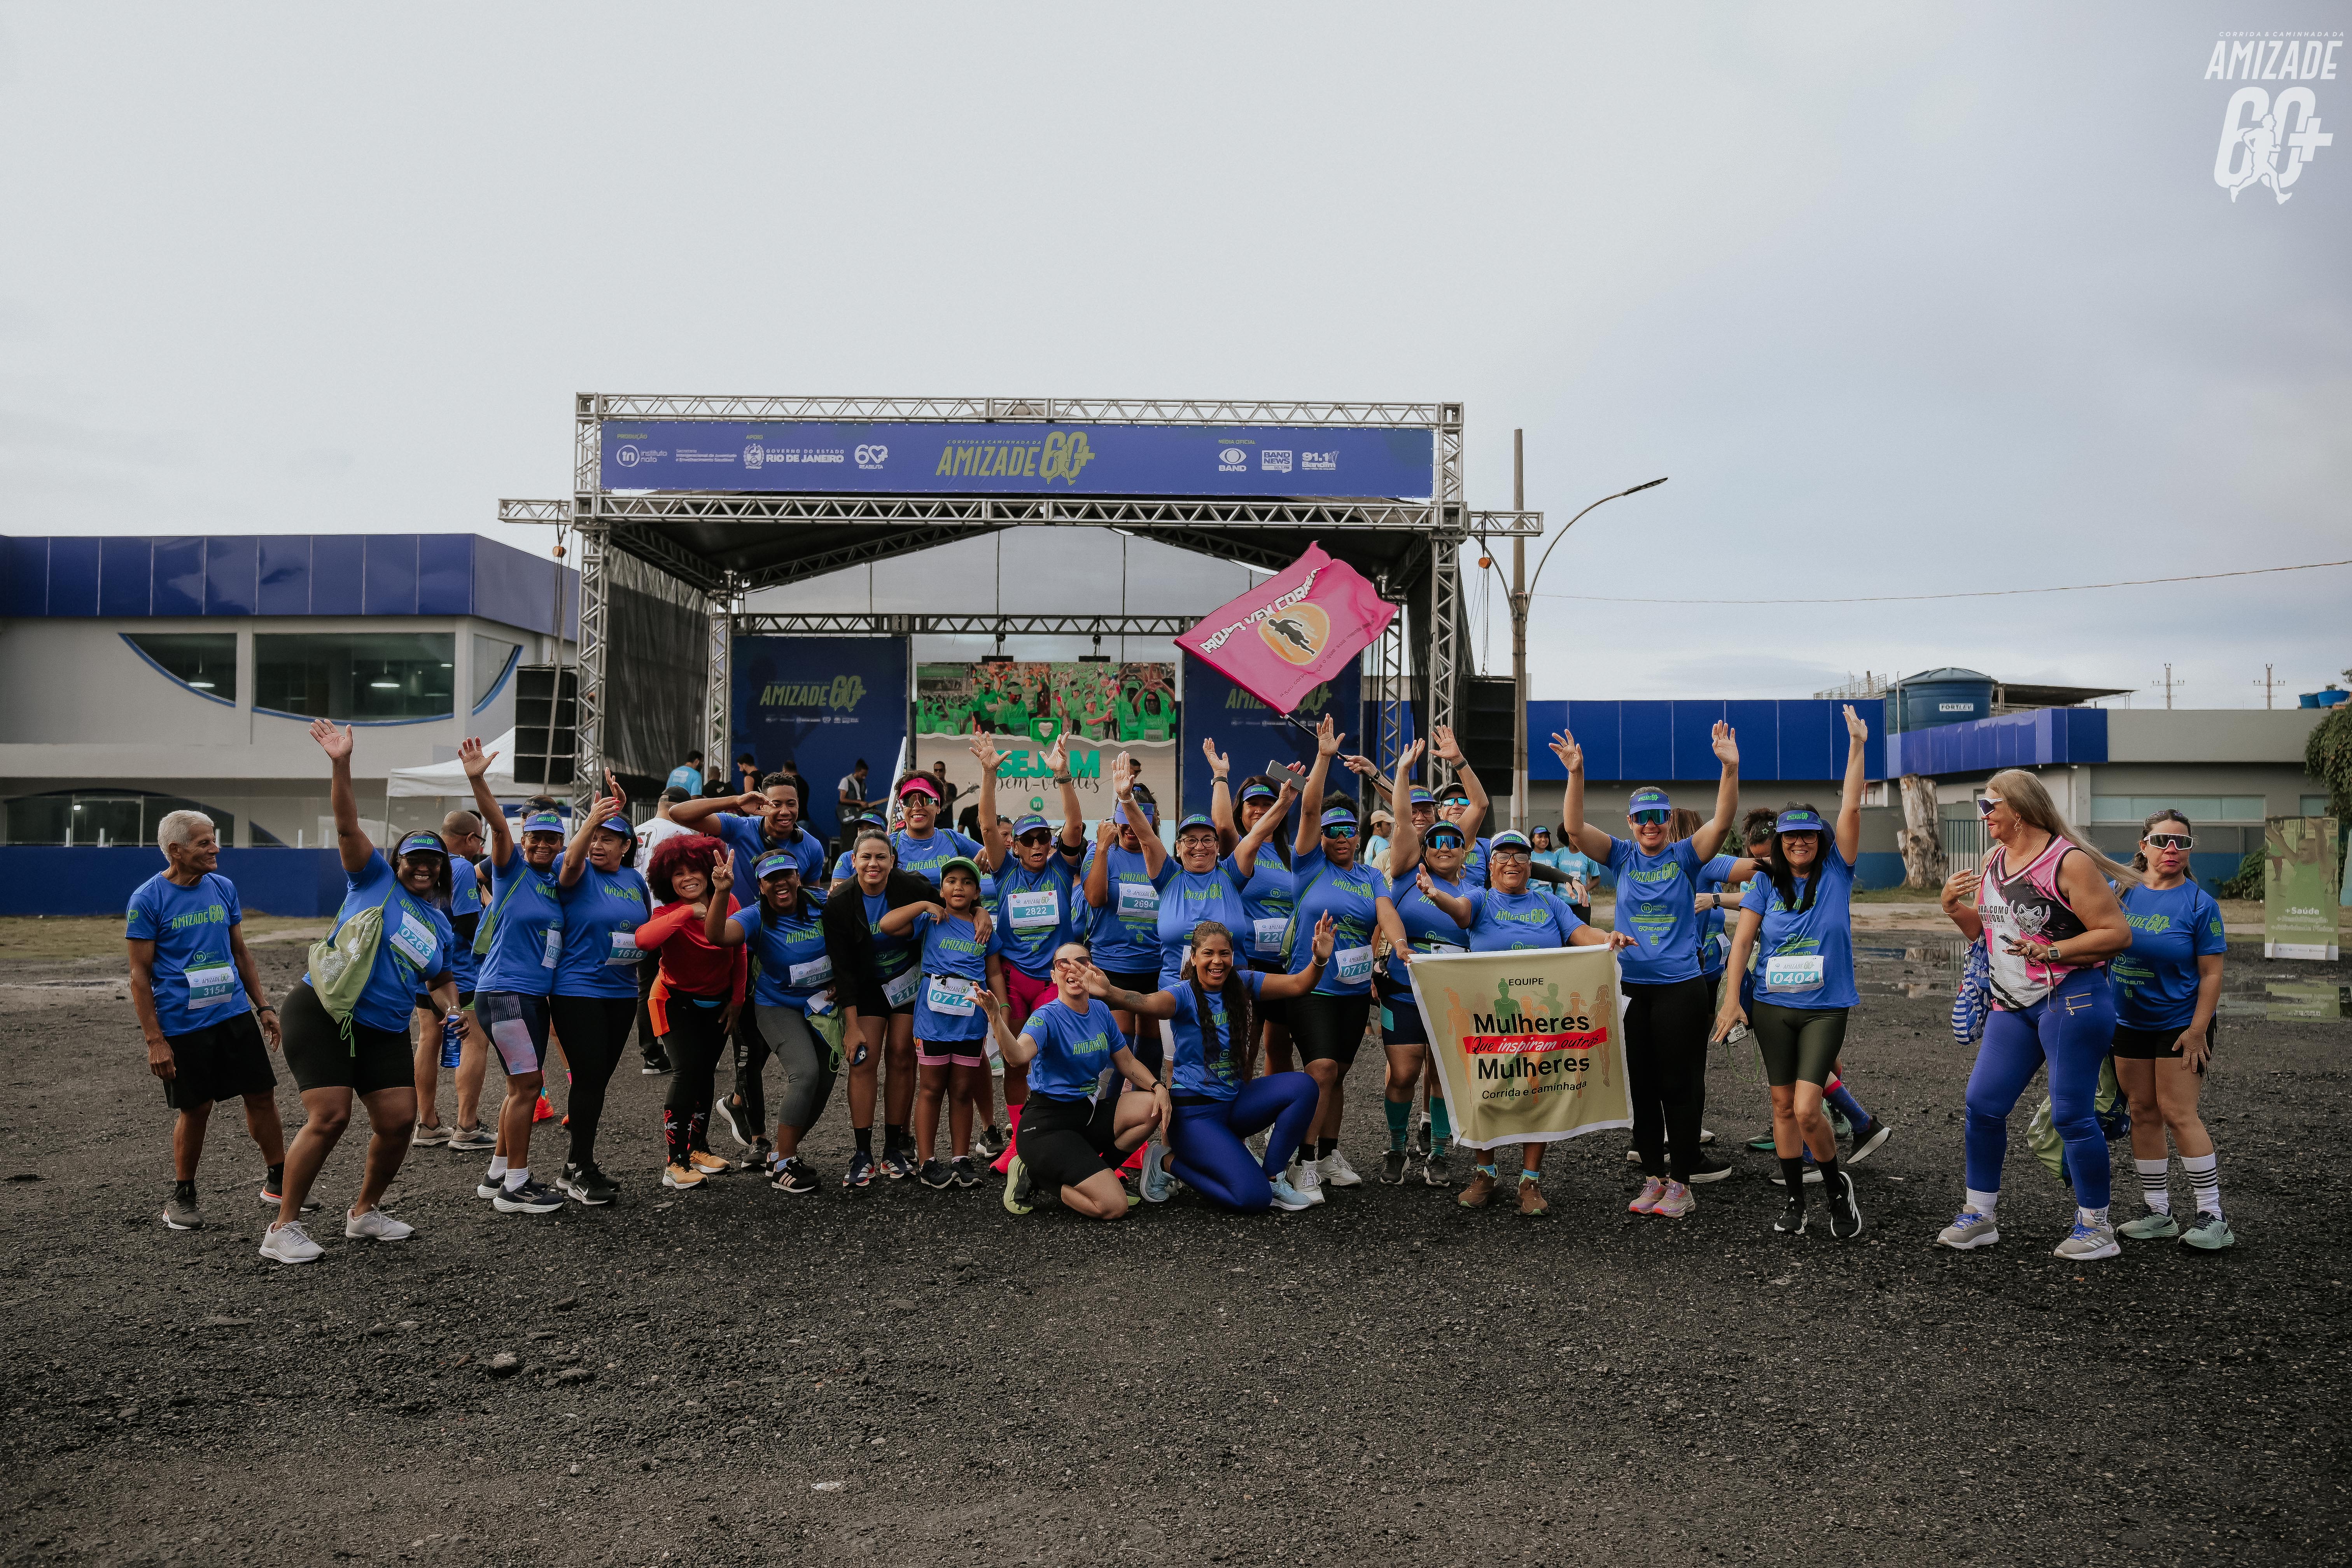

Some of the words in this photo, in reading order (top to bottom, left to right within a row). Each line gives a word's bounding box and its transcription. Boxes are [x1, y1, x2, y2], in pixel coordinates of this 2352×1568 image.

[766, 454, 785, 463] RIO
[785, 454, 800, 463] DE
[801, 454, 845, 463] JANEIRO
[935, 446, 1041, 476] AMIZADE
[1039, 431, 1096, 481] 60+
[1302, 452, 1329, 462] 91.1
[1326, 649, 1336, 660] que
[1335, 639, 1347, 649] sua
[759, 686, 830, 706] AMIZADE
[996, 749, 1101, 778] SEJM
[906, 859, 938, 871] AMIZADE
[1119, 873, 1150, 883] AMIZADE
[1025, 906, 1047, 916] 2822
[1134, 900, 1154, 909] 2694
[1989, 905, 2009, 915] COMO
[172, 911, 208, 930] AMIZADE
[1989, 914, 2005, 923] LOBA
[401, 928, 432, 957] 0263
[786, 927, 819, 944] AMIZADE
[1264, 933, 1283, 942] 22
[939, 938, 975, 953] AMIZADE
[618, 949, 643, 958] 1616
[1343, 962, 1369, 976] 0713
[202, 976, 220, 984] AMIZADE
[1508, 977, 1544, 986] EQUIPE
[1773, 972, 1815, 984] 0404
[204, 985, 226, 996] 3154
[932, 992, 970, 1006] 0712
[1472, 1013, 1590, 1034] Mulheres
[1073, 1040, 1101, 1055] AMIZADE
[1472, 1036, 1494, 1055] Que
[1497, 1037, 1557, 1057] inspiram
[1560, 1034, 1600, 1049] outras
[1478, 1056, 1590, 1080] Mulheres
[1481, 1088, 1521, 1100] Corrida
[1531, 1080, 1587, 1095] caminhada
